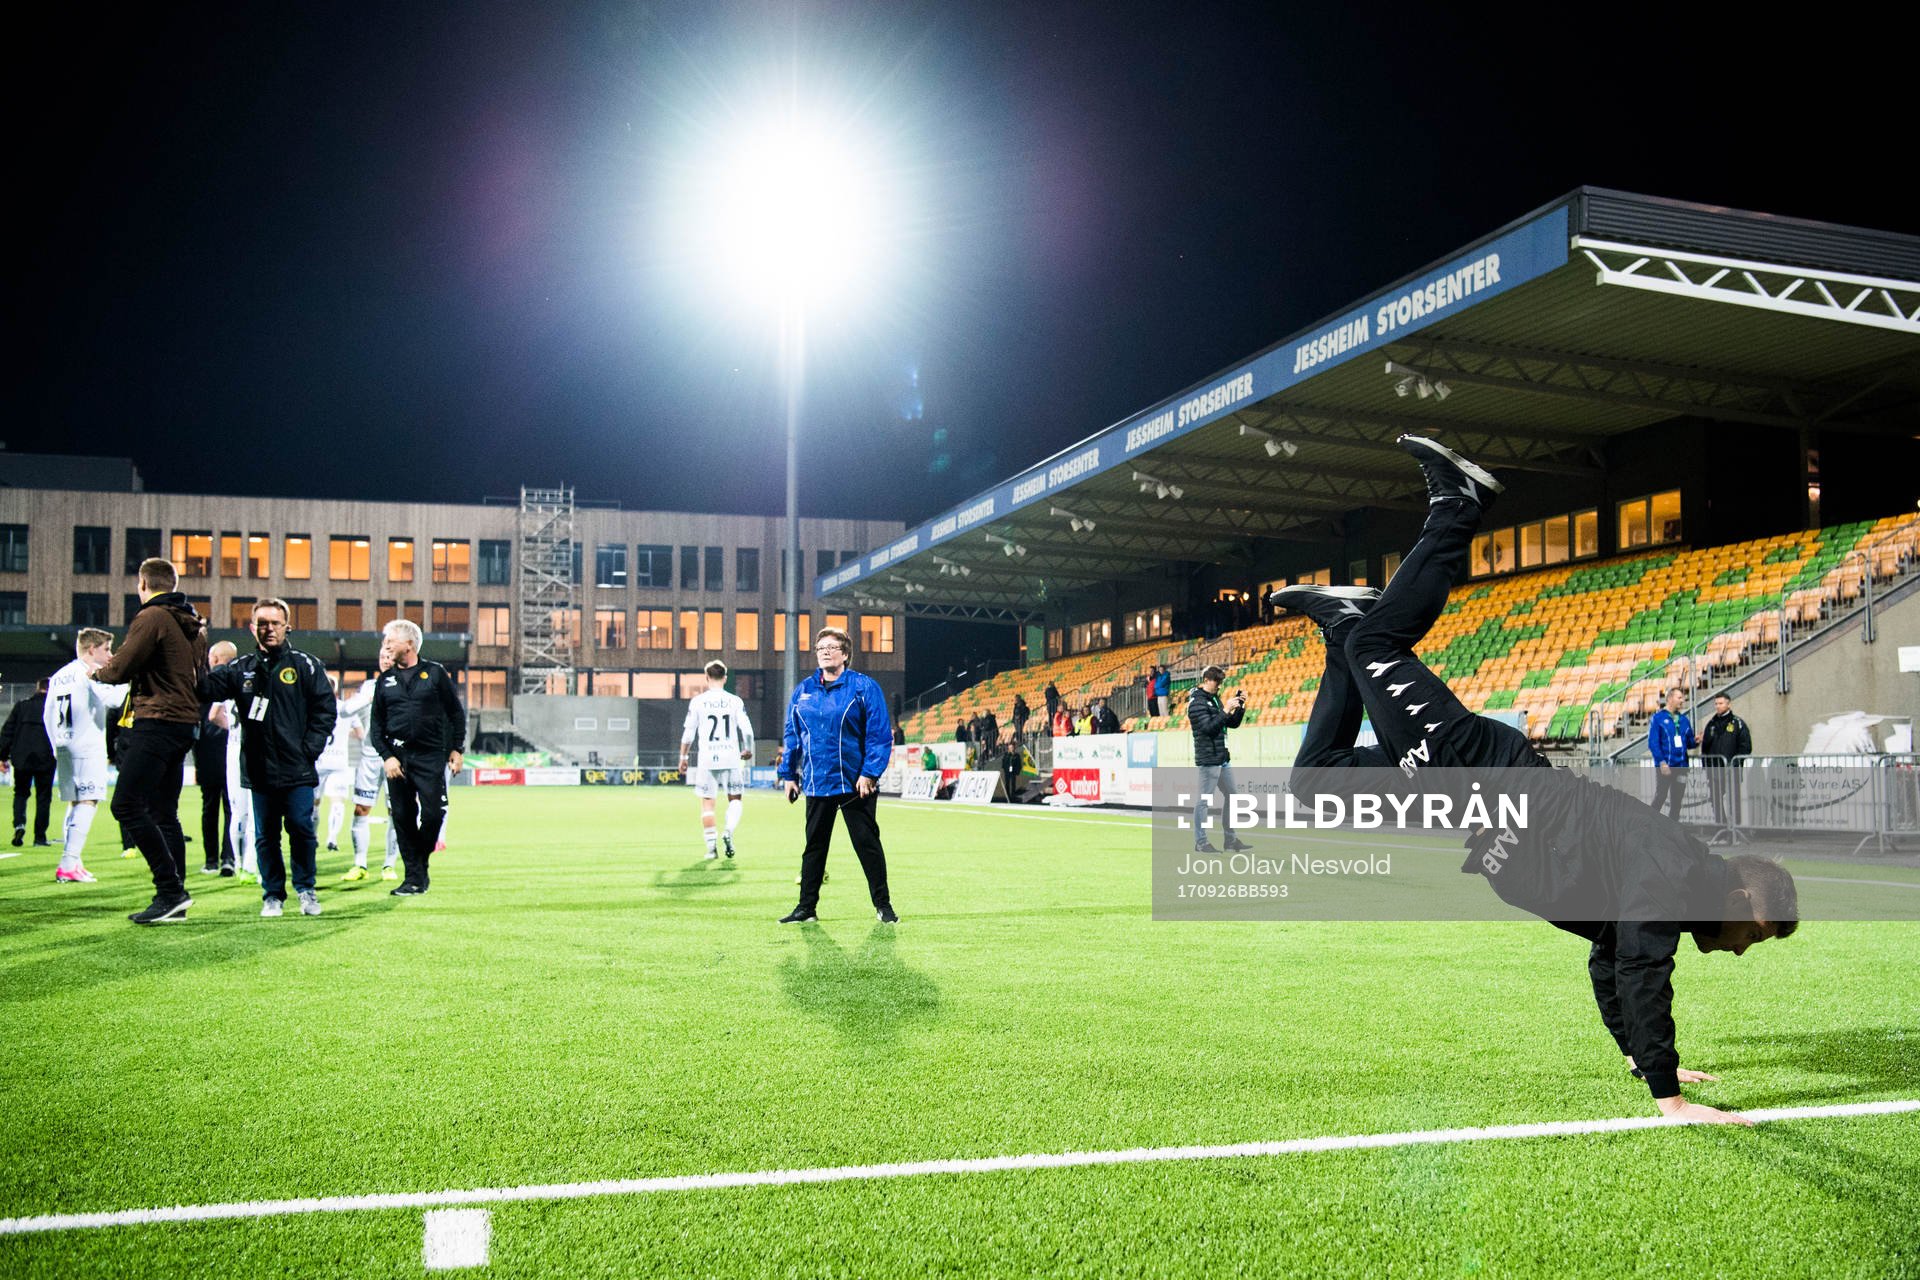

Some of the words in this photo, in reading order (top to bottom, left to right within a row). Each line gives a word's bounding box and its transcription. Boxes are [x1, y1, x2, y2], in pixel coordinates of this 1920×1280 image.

[1293, 314, 1369, 375] JESSHEIM
[1376, 253, 1501, 336] STORSENTER
[1125, 410, 1174, 453] JESSHEIM
[1177, 372, 1253, 428] STORSENTER
[1012, 473, 1046, 506] JESSHEIM
[1048, 448, 1099, 489] STORSENTER
[707, 714, 731, 742] 21
[1070, 776, 1099, 796] umbro
[1248, 781, 1279, 793] Eiendom
[1808, 778, 1839, 789] Vare
[1841, 778, 1862, 789] AS
